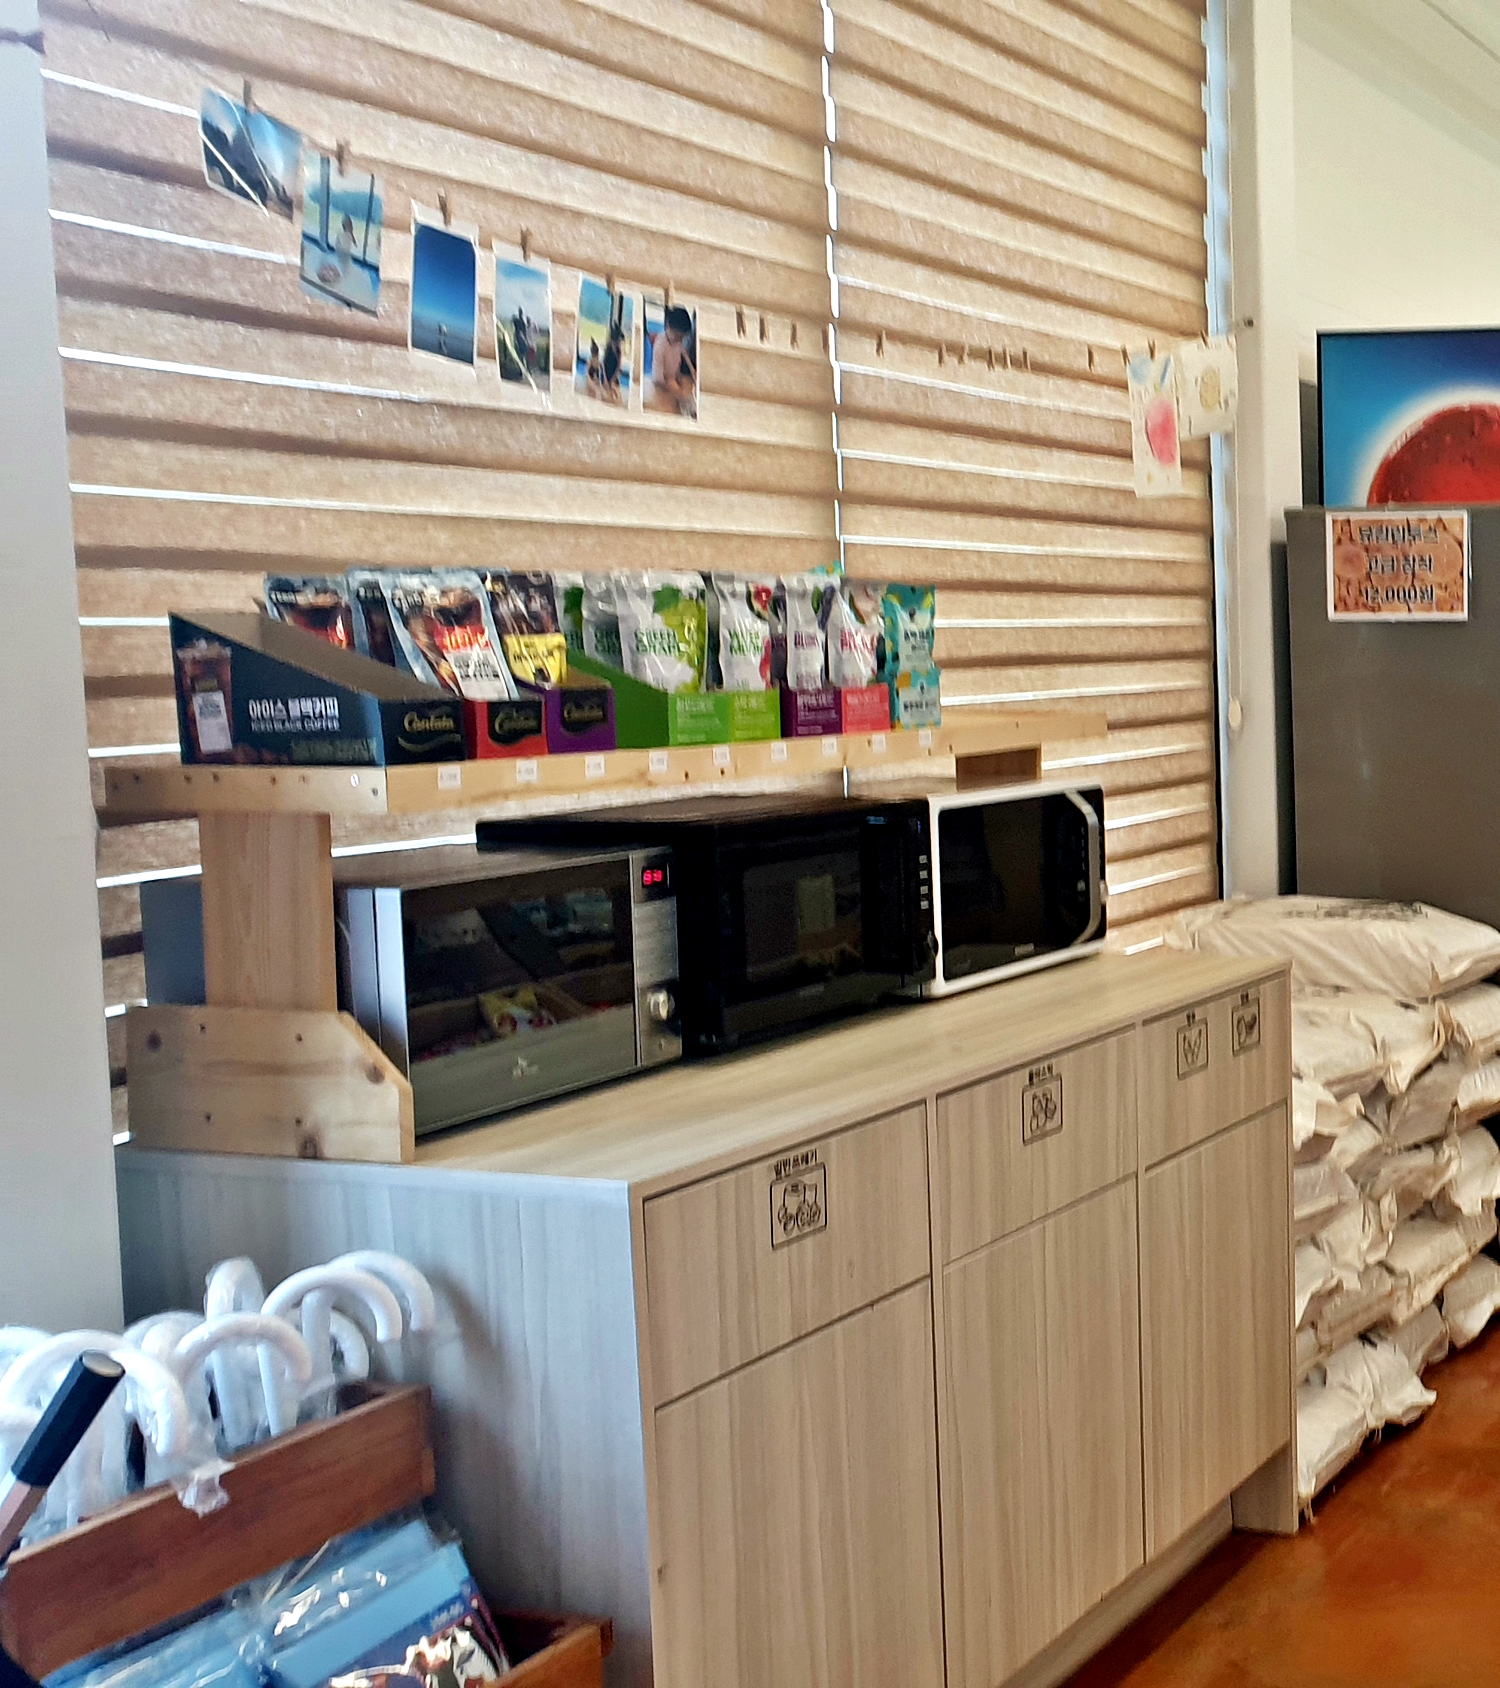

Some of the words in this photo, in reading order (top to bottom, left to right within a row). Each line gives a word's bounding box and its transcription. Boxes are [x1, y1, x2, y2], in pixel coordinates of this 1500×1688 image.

[1364, 584, 1435, 605] 12,000원
[249, 698, 287, 719] 아이스
[288, 697, 339, 718] 블랙커피
